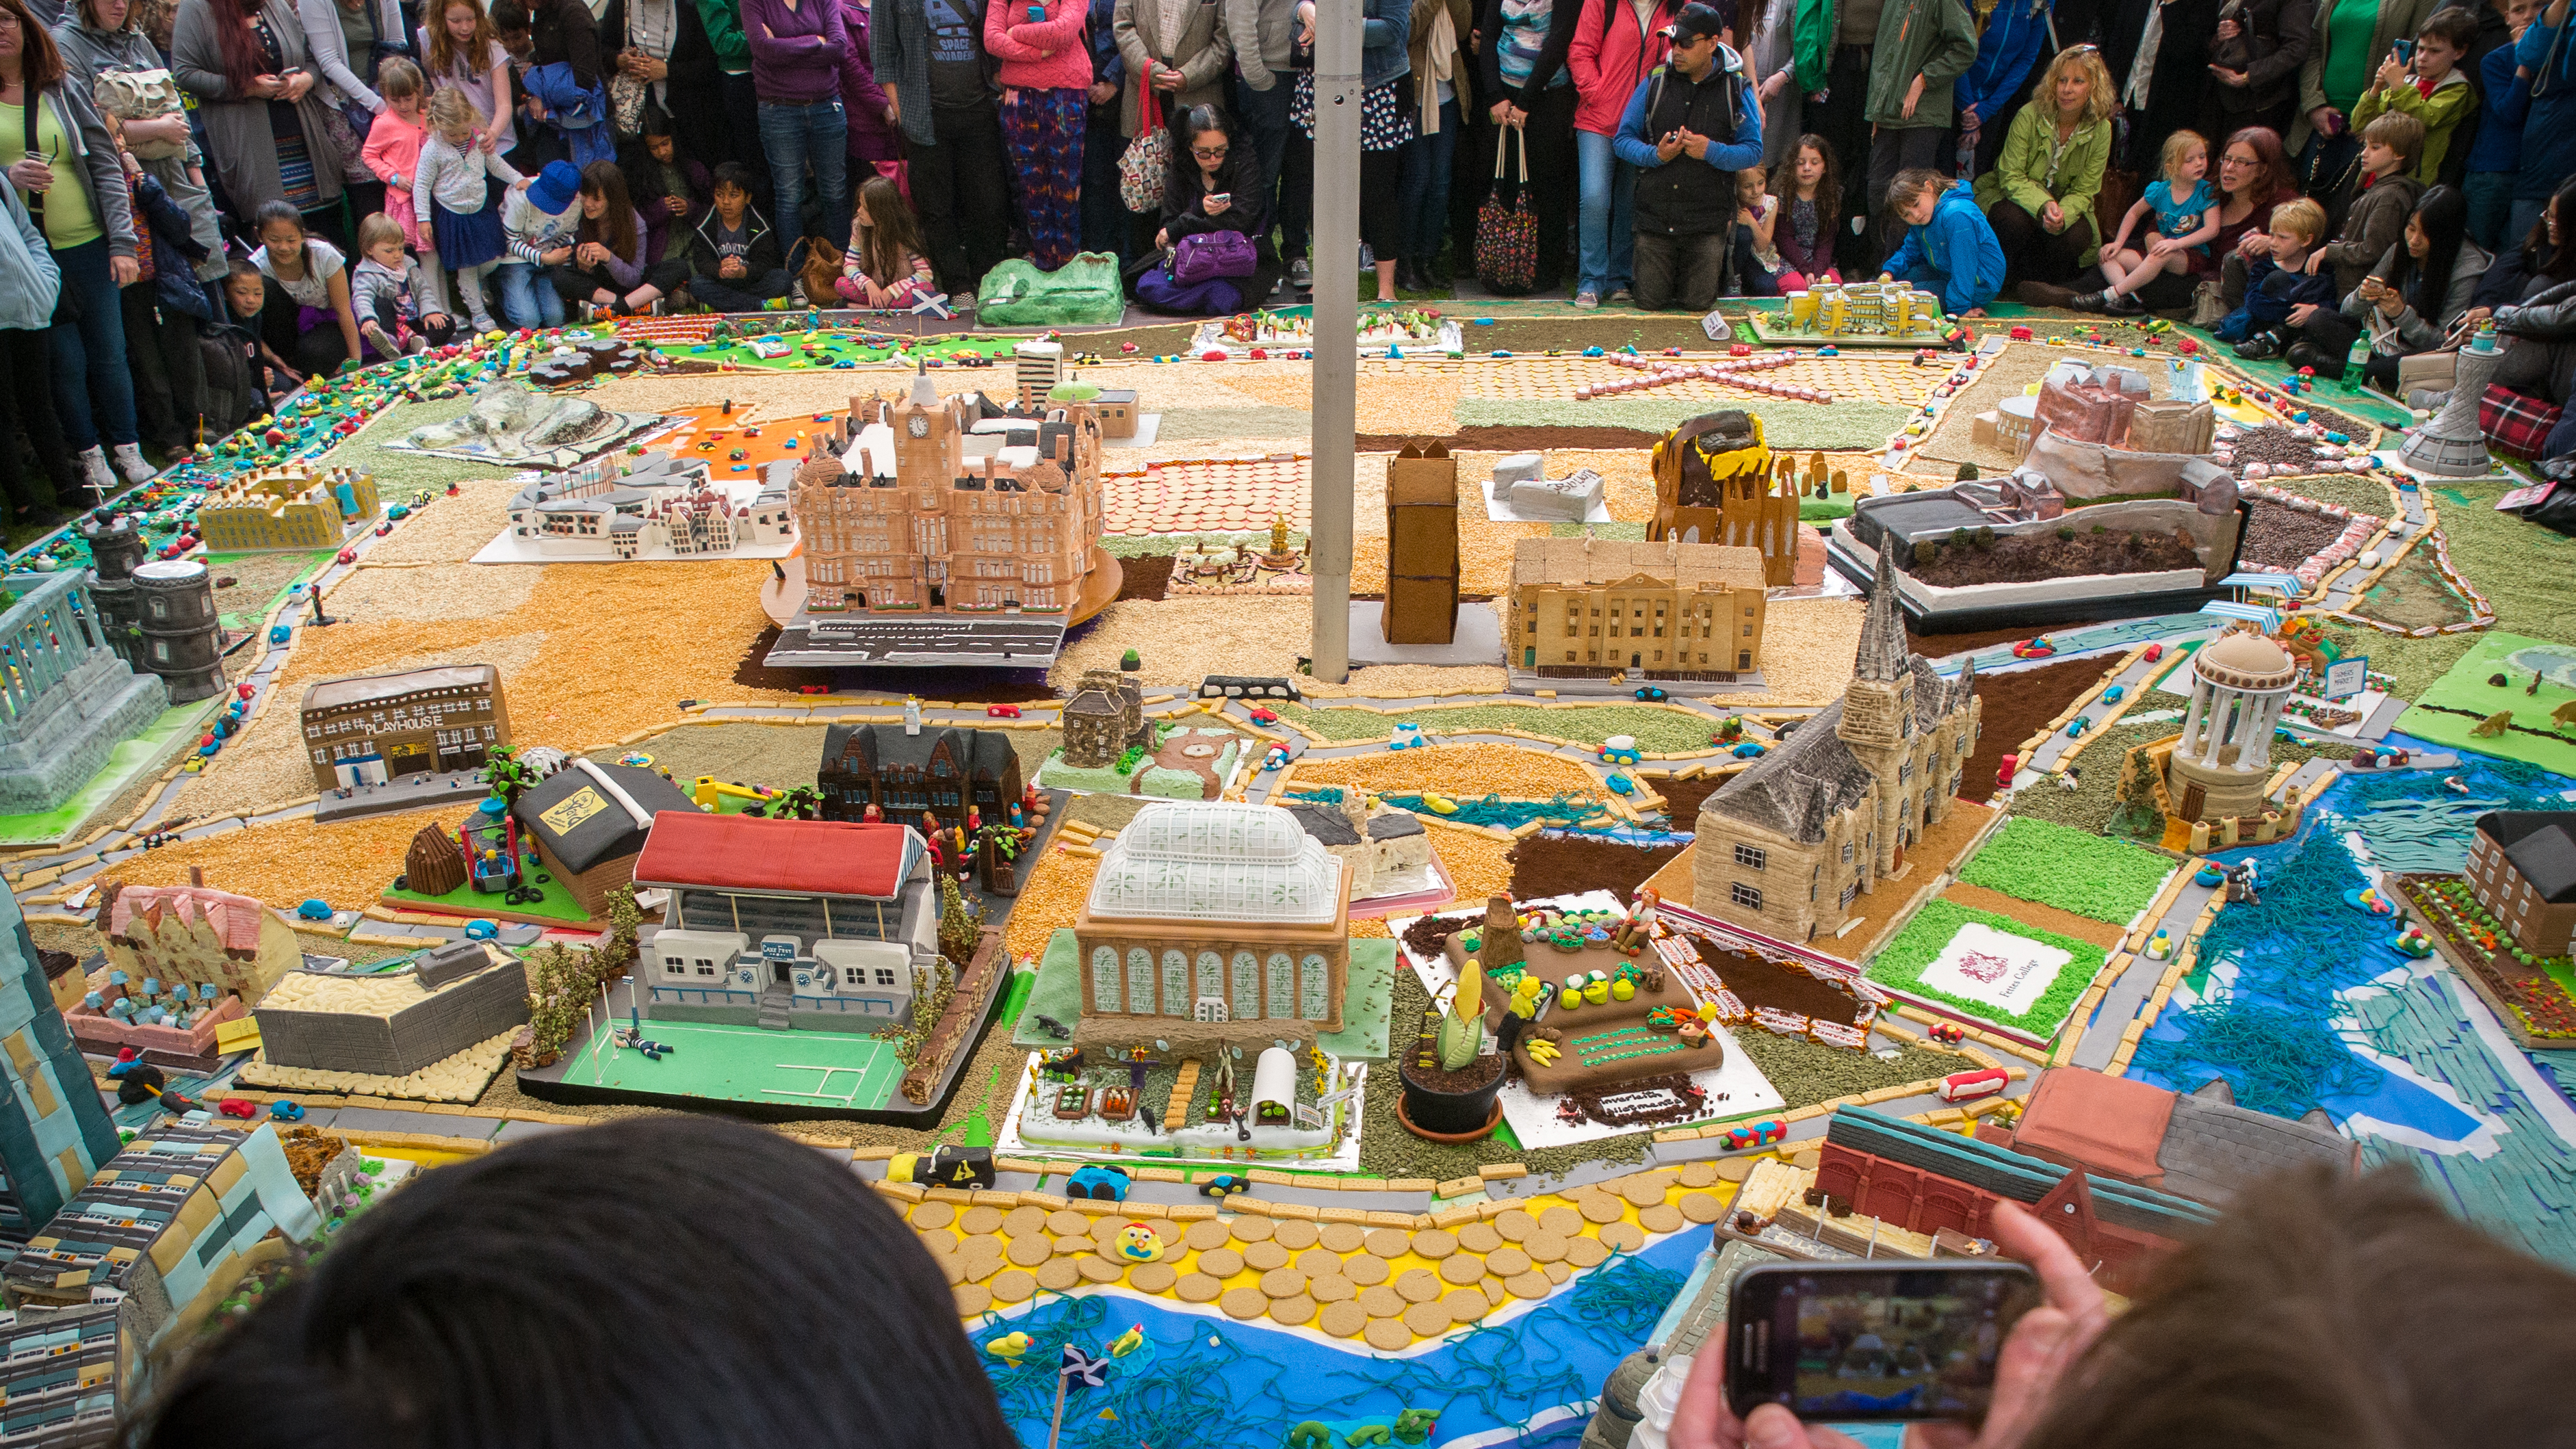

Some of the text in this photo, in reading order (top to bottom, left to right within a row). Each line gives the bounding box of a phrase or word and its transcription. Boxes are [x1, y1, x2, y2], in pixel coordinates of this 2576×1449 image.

[939, 38, 970, 51] SPACE
[365, 715, 444, 736] PLAYHOUSE
[1708, 932, 1745, 949] CARAMEL
[1661, 940, 1682, 963] CARAMEL
[1684, 965, 1702, 987] CARAMEL
[1699, 965, 1719, 987] CARAMEL
[1804, 961, 1843, 978] CARAMEL
[1999, 959, 2039, 998] Fettes College
[1850, 979, 1884, 1001] CARAMEL
[1721, 991, 1742, 1015] CARAMEL
[1814, 1028, 1858, 1044] CARAMEL
[1599, 1091, 1663, 1105] Inverleith
